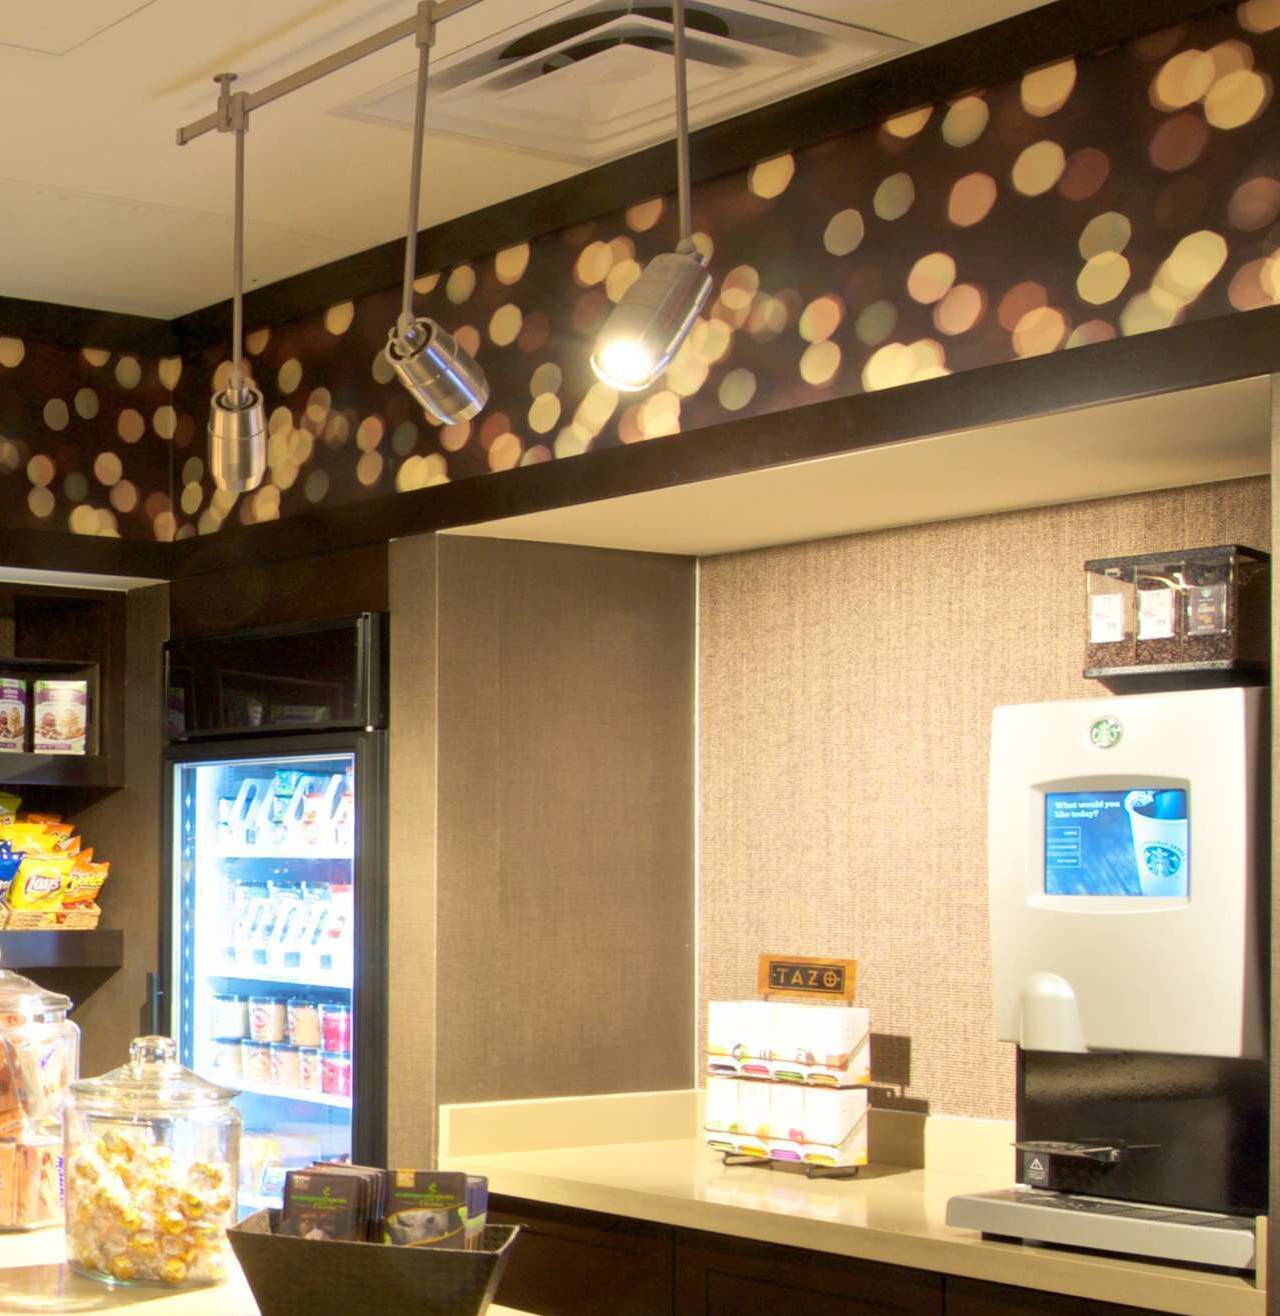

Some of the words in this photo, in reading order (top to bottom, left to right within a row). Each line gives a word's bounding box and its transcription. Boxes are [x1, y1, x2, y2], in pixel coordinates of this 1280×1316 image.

[1055, 801, 1077, 809] What
[1079, 800, 1104, 808] would
[1055, 810, 1070, 818] like
[1071, 810, 1099, 819] today?
[776, 967, 837, 988] TAZO
